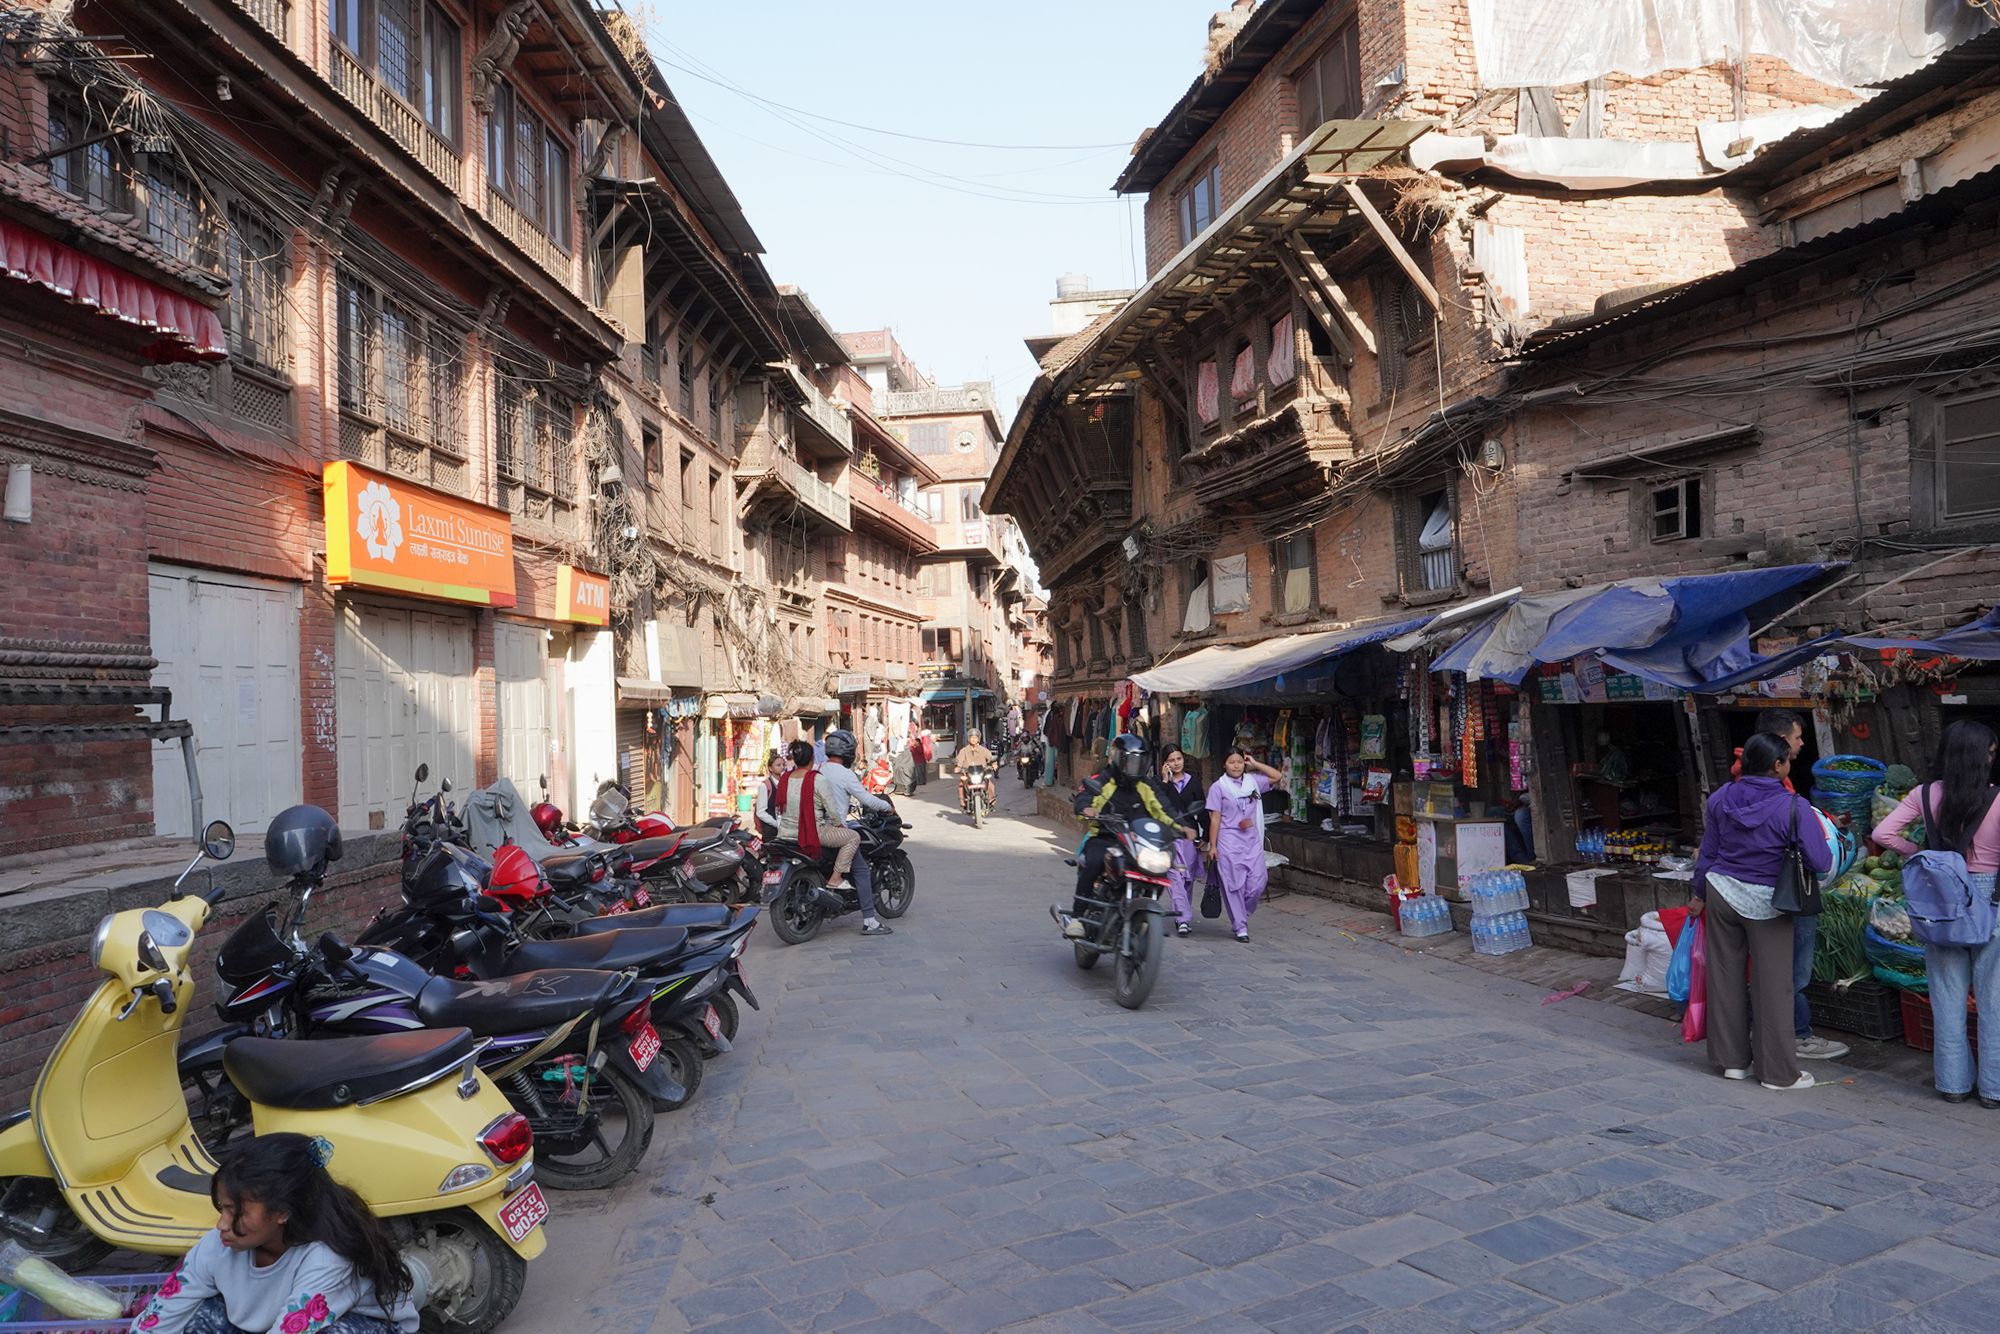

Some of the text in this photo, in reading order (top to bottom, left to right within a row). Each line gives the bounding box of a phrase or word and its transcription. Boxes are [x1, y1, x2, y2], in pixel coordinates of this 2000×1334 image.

[408, 504, 505, 552] Laxmi Sunrise
[576, 581, 604, 608] ATM
[510, 1201, 546, 1238] ७०६३
